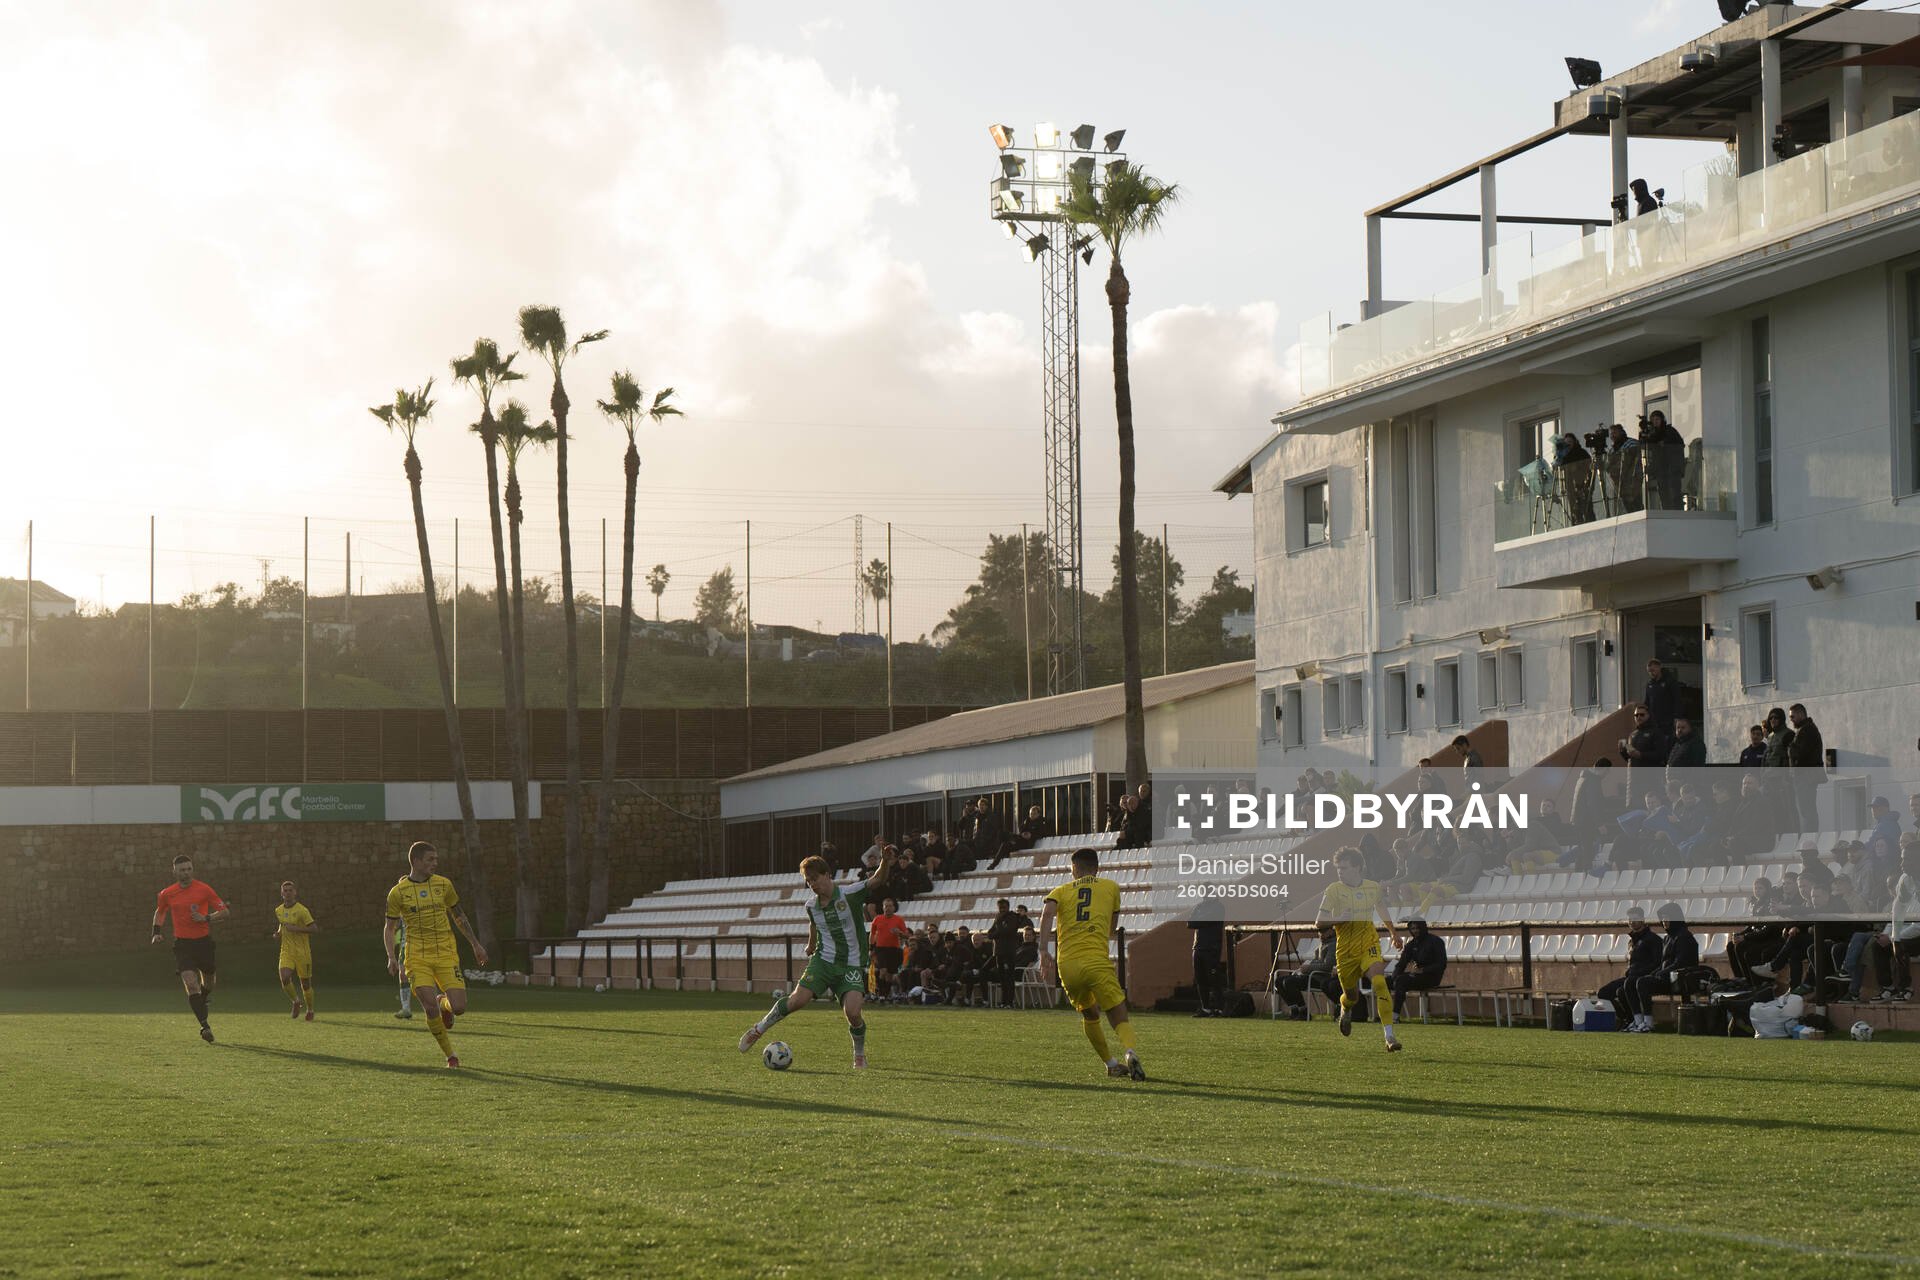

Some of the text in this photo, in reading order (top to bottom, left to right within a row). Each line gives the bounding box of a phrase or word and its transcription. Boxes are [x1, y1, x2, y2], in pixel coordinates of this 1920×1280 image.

[302, 796, 340, 804] Marbella
[302, 803, 366, 811] Football Center
[1076, 887, 1092, 921] 2
